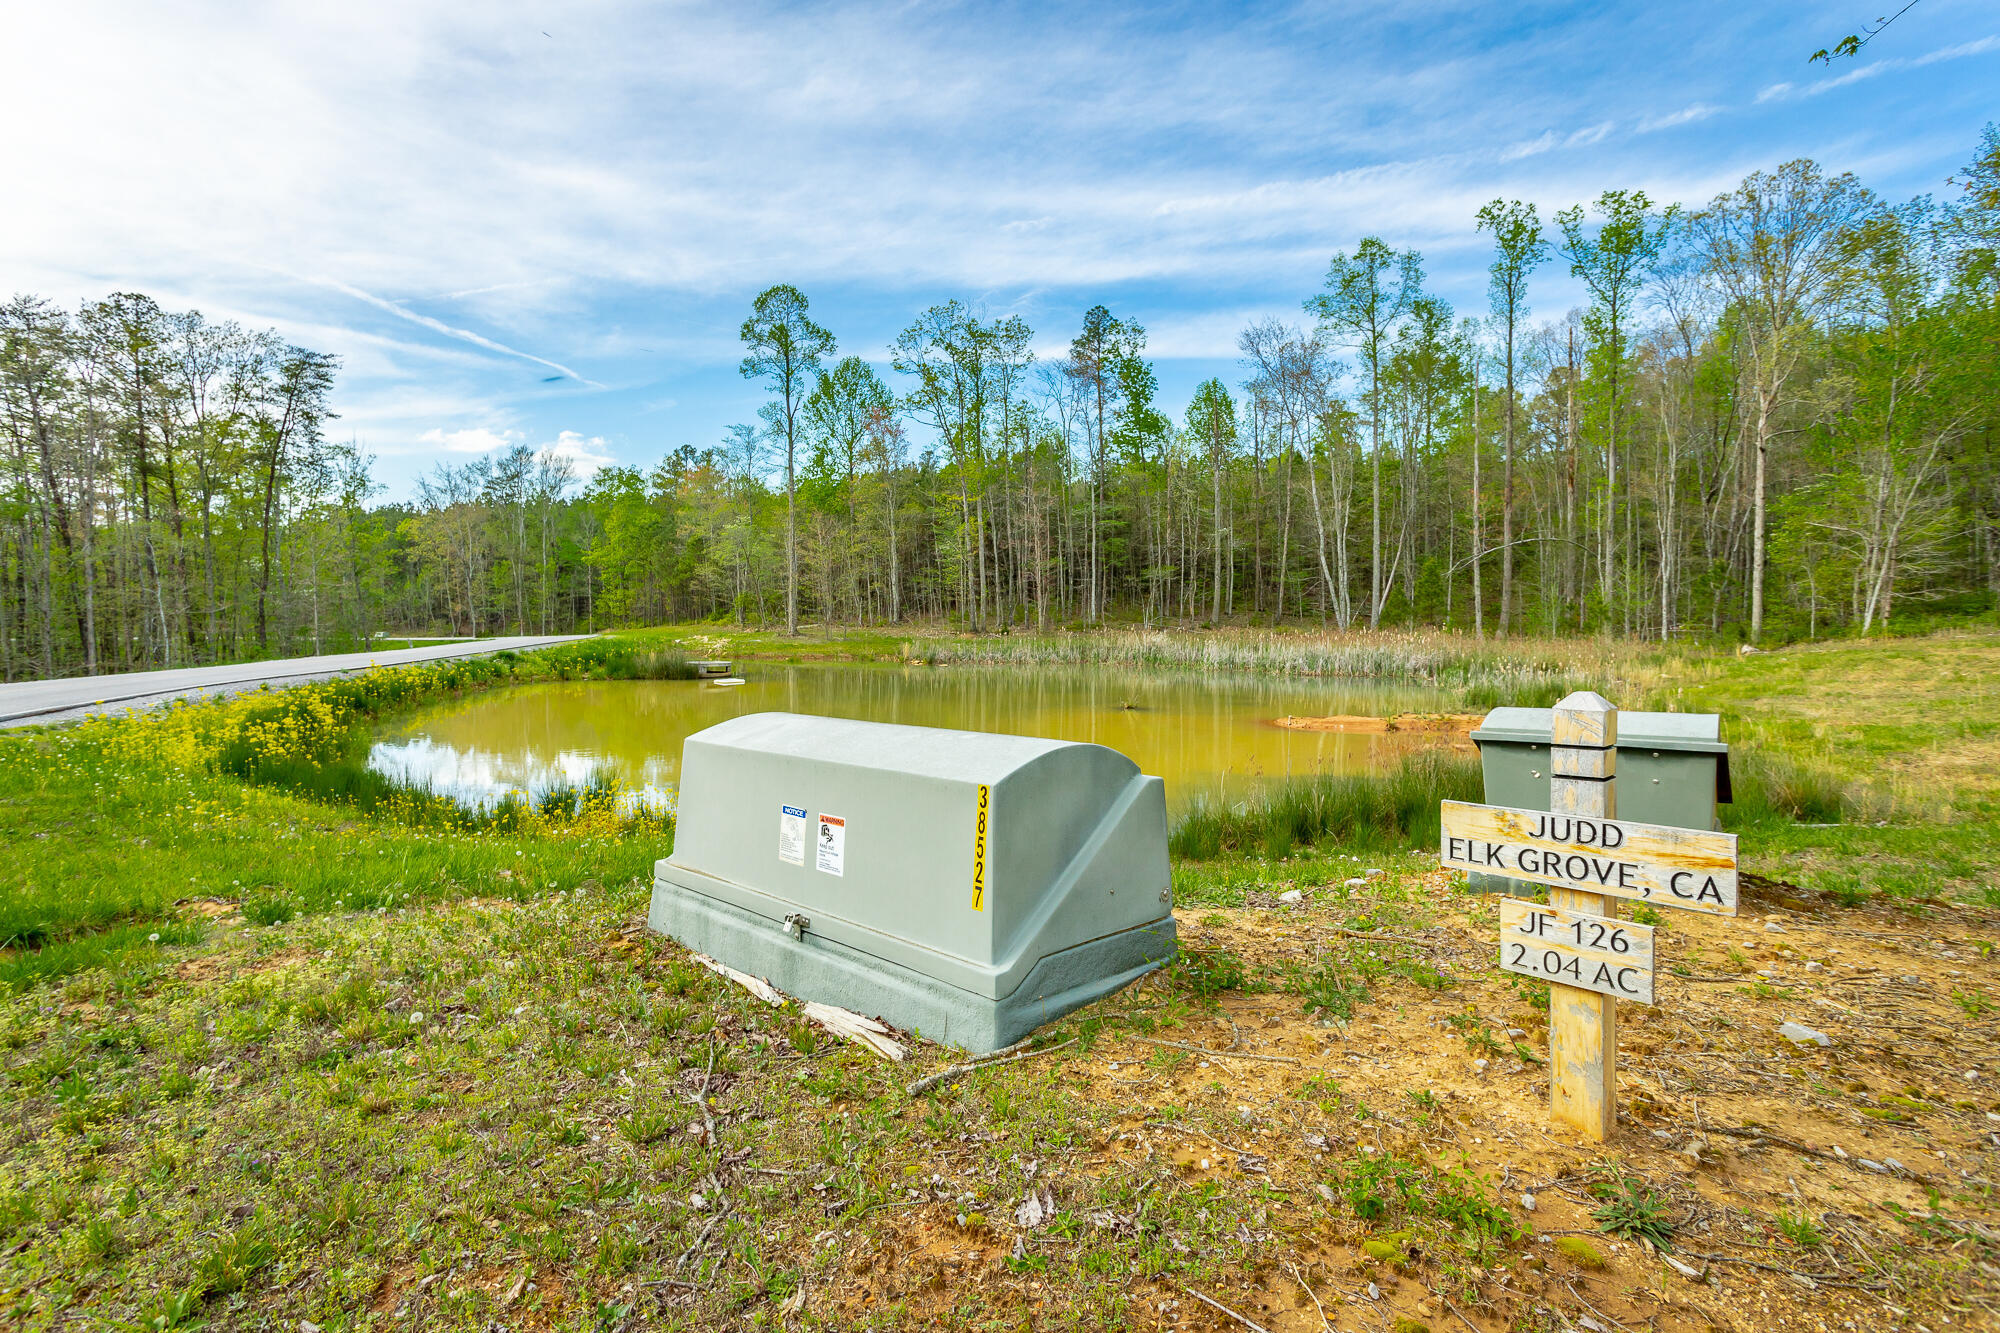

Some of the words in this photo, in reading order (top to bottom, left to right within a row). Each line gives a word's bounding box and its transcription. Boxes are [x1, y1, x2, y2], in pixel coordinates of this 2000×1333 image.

[783, 806, 804, 818] NOTICE
[1528, 815, 1624, 848] JUDD
[974, 785, 988, 908] 38527
[1449, 837, 1506, 869] ELK
[1517, 848, 1651, 898] GROVE,
[1670, 871, 1725, 906] CA
[1519, 911, 1557, 937] JF
[1570, 920, 1630, 954] 126
[1511, 943, 1582, 983] 2.04
[1592, 962, 1639, 994] AC
